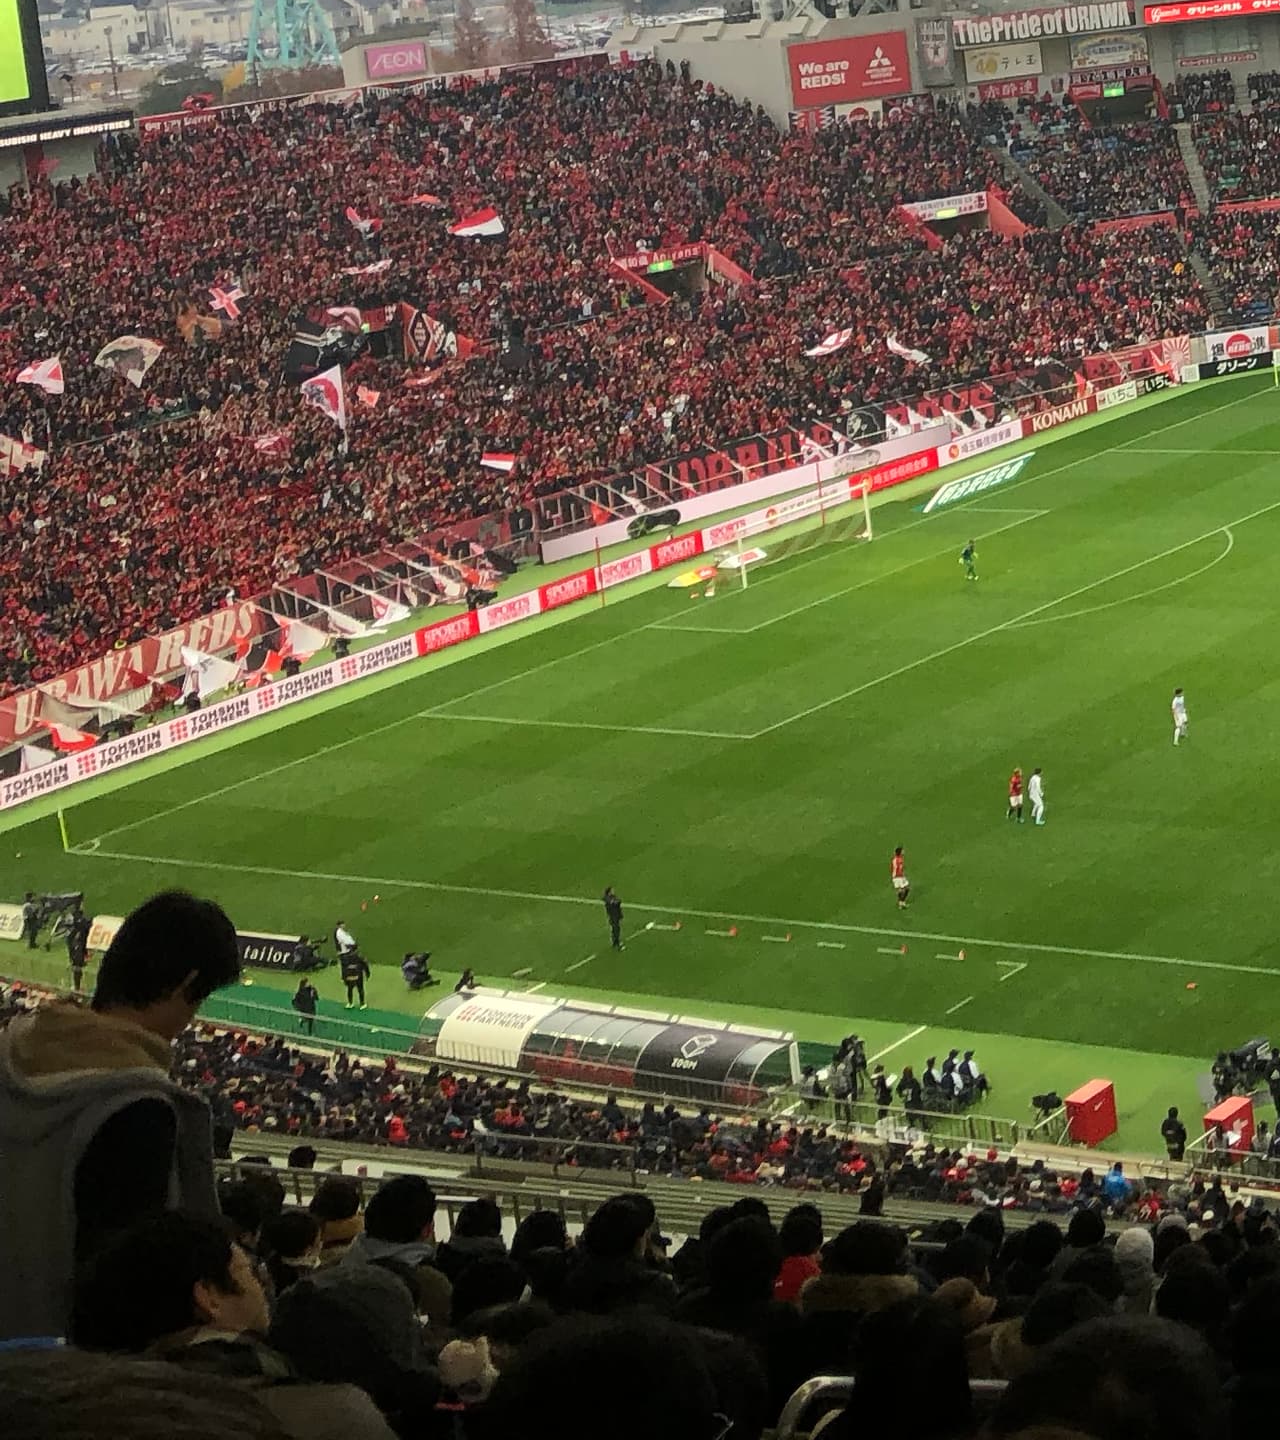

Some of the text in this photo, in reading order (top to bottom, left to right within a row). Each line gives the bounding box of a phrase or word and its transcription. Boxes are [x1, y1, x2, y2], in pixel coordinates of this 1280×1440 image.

[956, 19, 991, 45] The
[992, 11, 1041, 43] Pride
[1043, 10, 1063, 36] of
[1064, 3, 1131, 32] URAWA
[798, 59, 849, 76] We are
[801, 72, 846, 90] REDS!
[40, 128, 71, 142] HEAVY
[73, 119, 131, 137] INDUSTRIES
[1106, 385, 1136, 407] いちご
[1032, 399, 1088, 432] KONAMI
[709, 519, 746, 539] SPORTS
[656, 536, 695, 557] SPORTS
[602, 556, 641, 577] SPORTS
[546, 575, 587, 599] SPORTS
[487, 596, 530, 620] SPORTS
[424, 617, 470, 643] SPORTS
[360, 641, 412, 665] TOHSHIN
[360, 648, 413, 673] PARTNERS
[14, 600, 256, 735] URAWA REDS
[277, 668, 333, 694] TOHSHIN
[278, 676, 334, 703] PARTNERS
[190, 698, 249, 726] TOHSHIN
[192, 707, 250, 735] PARTNERS
[99, 730, 161, 759] TOHSHIN
[100, 739, 162, 769] PARTNERS
[4, 763, 68, 793] TOHSHIN
[6, 772, 69, 802] PARTNERS
[243, 945, 291, 964] tailor
